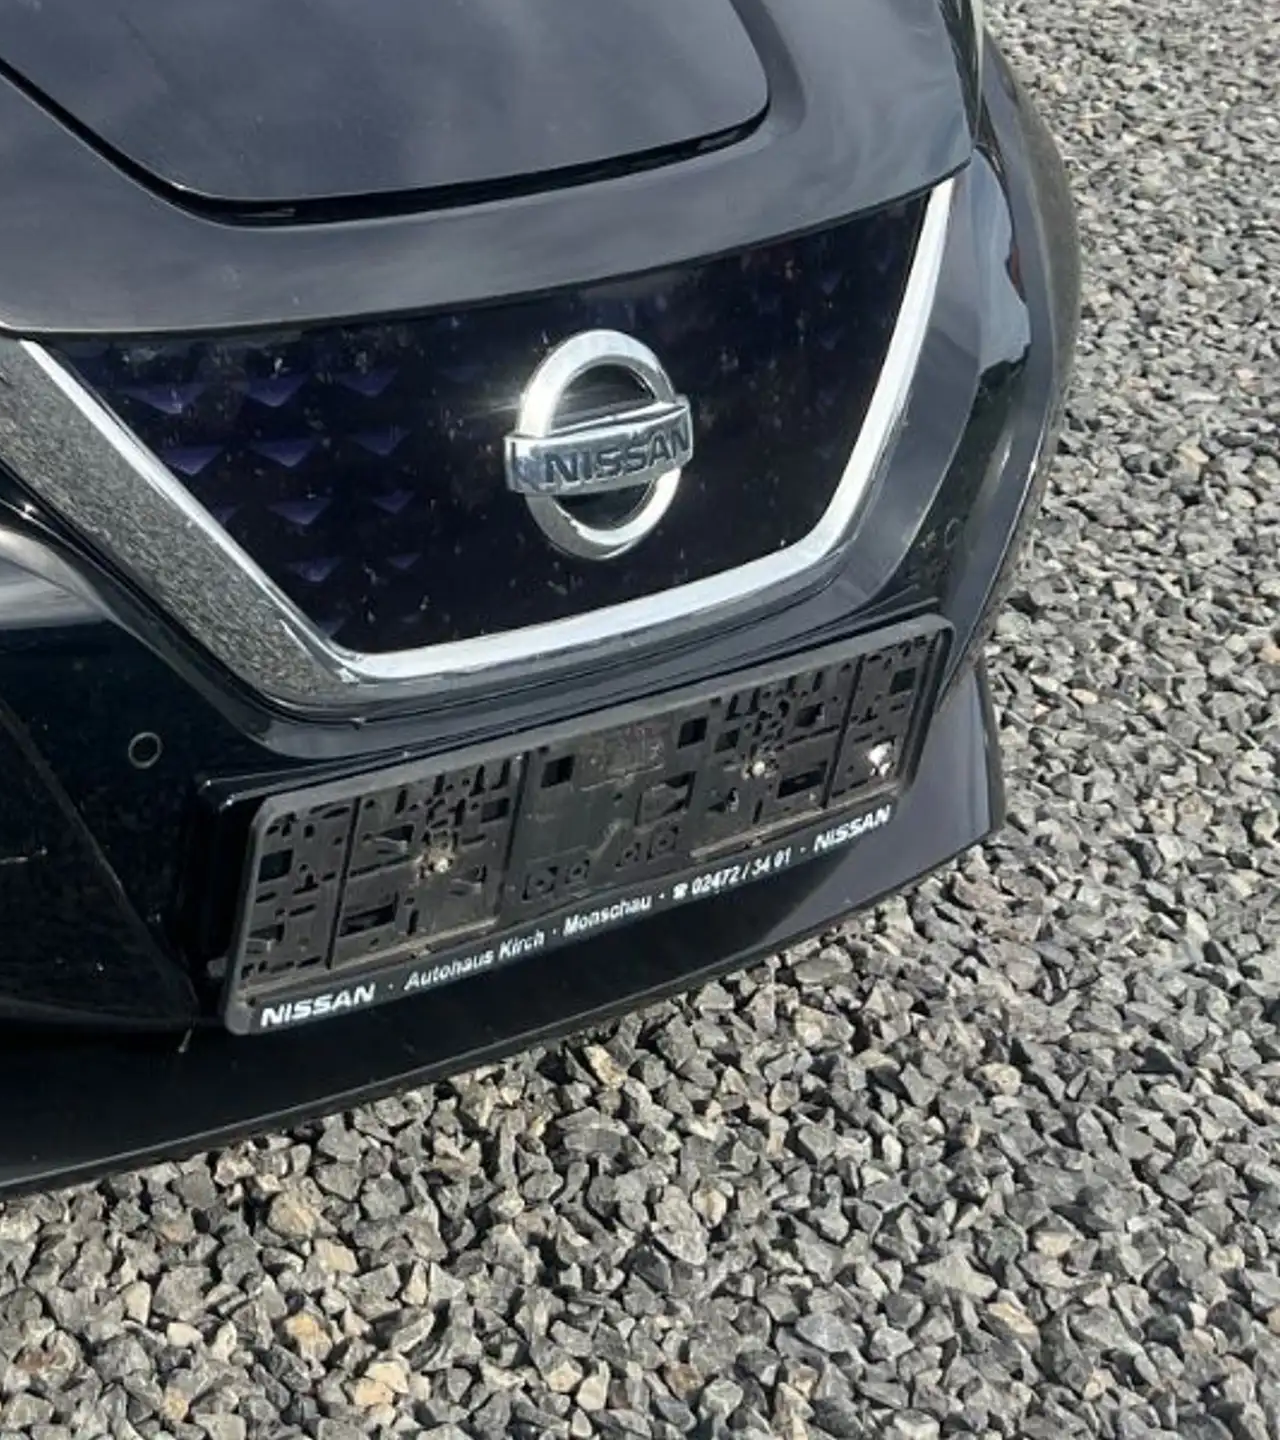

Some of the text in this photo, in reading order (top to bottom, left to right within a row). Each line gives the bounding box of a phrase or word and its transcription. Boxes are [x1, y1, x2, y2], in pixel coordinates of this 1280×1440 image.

[544, 417, 690, 484] NISSAN
[260, 983, 376, 1028] NISSAN
[403, 947, 495, 991] Autohaus
[497, 930, 545, 960] Kirch
[563, 893, 653, 937] Monschau
[814, 804, 892, 852] NISSAN
